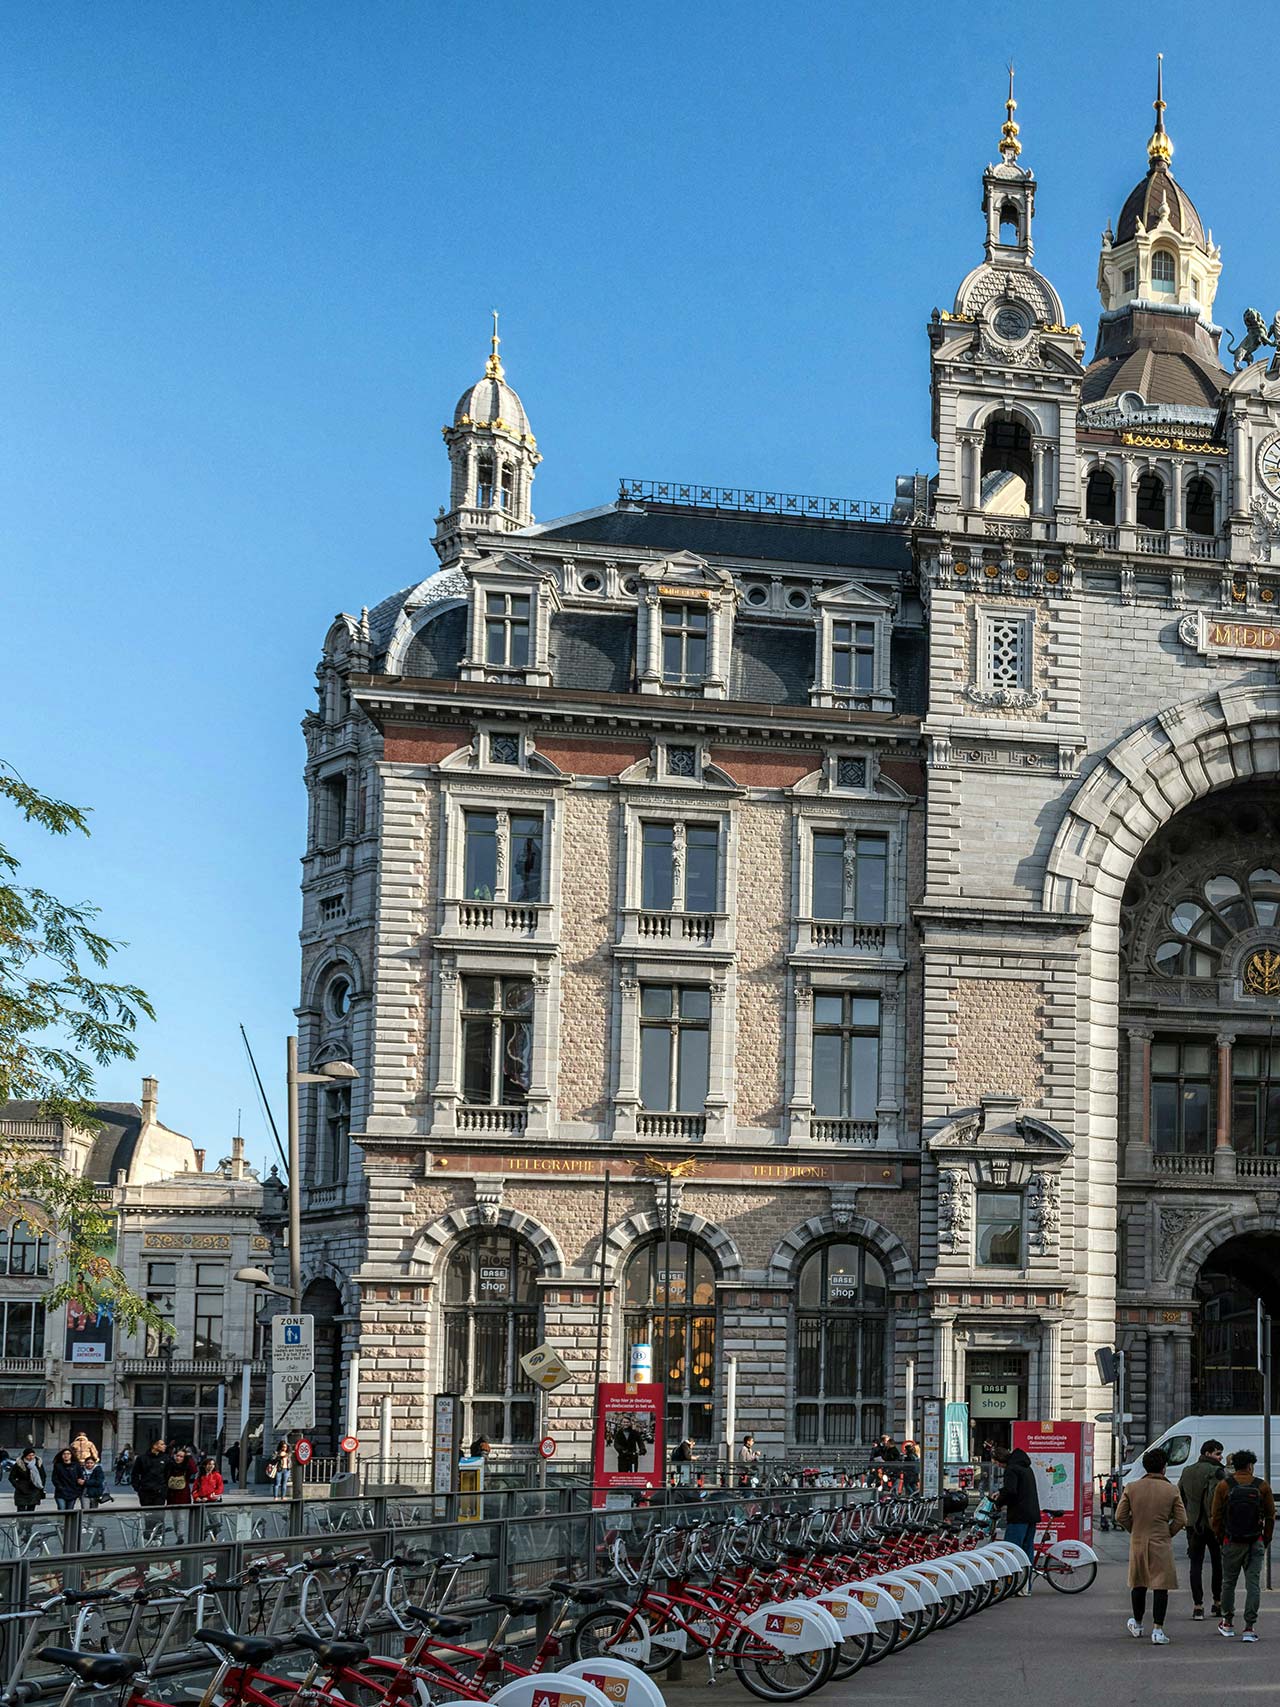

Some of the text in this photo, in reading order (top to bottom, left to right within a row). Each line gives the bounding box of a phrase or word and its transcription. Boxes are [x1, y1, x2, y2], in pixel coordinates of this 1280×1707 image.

[508, 1158, 595, 1172] TELEGRAPHE
[751, 1164, 828, 1178] TELEPHONE
[76, 1219, 113, 1227] JULE
[81, 1226, 109, 1234] BOK
[481, 1281, 506, 1293] shop
[831, 1288, 855, 1299] shop
[281, 1375, 305, 1383] ZONE
[982, 1399, 1007, 1409] shop
[770, 1619, 779, 1629] A
[539, 1696, 551, 1707] A
